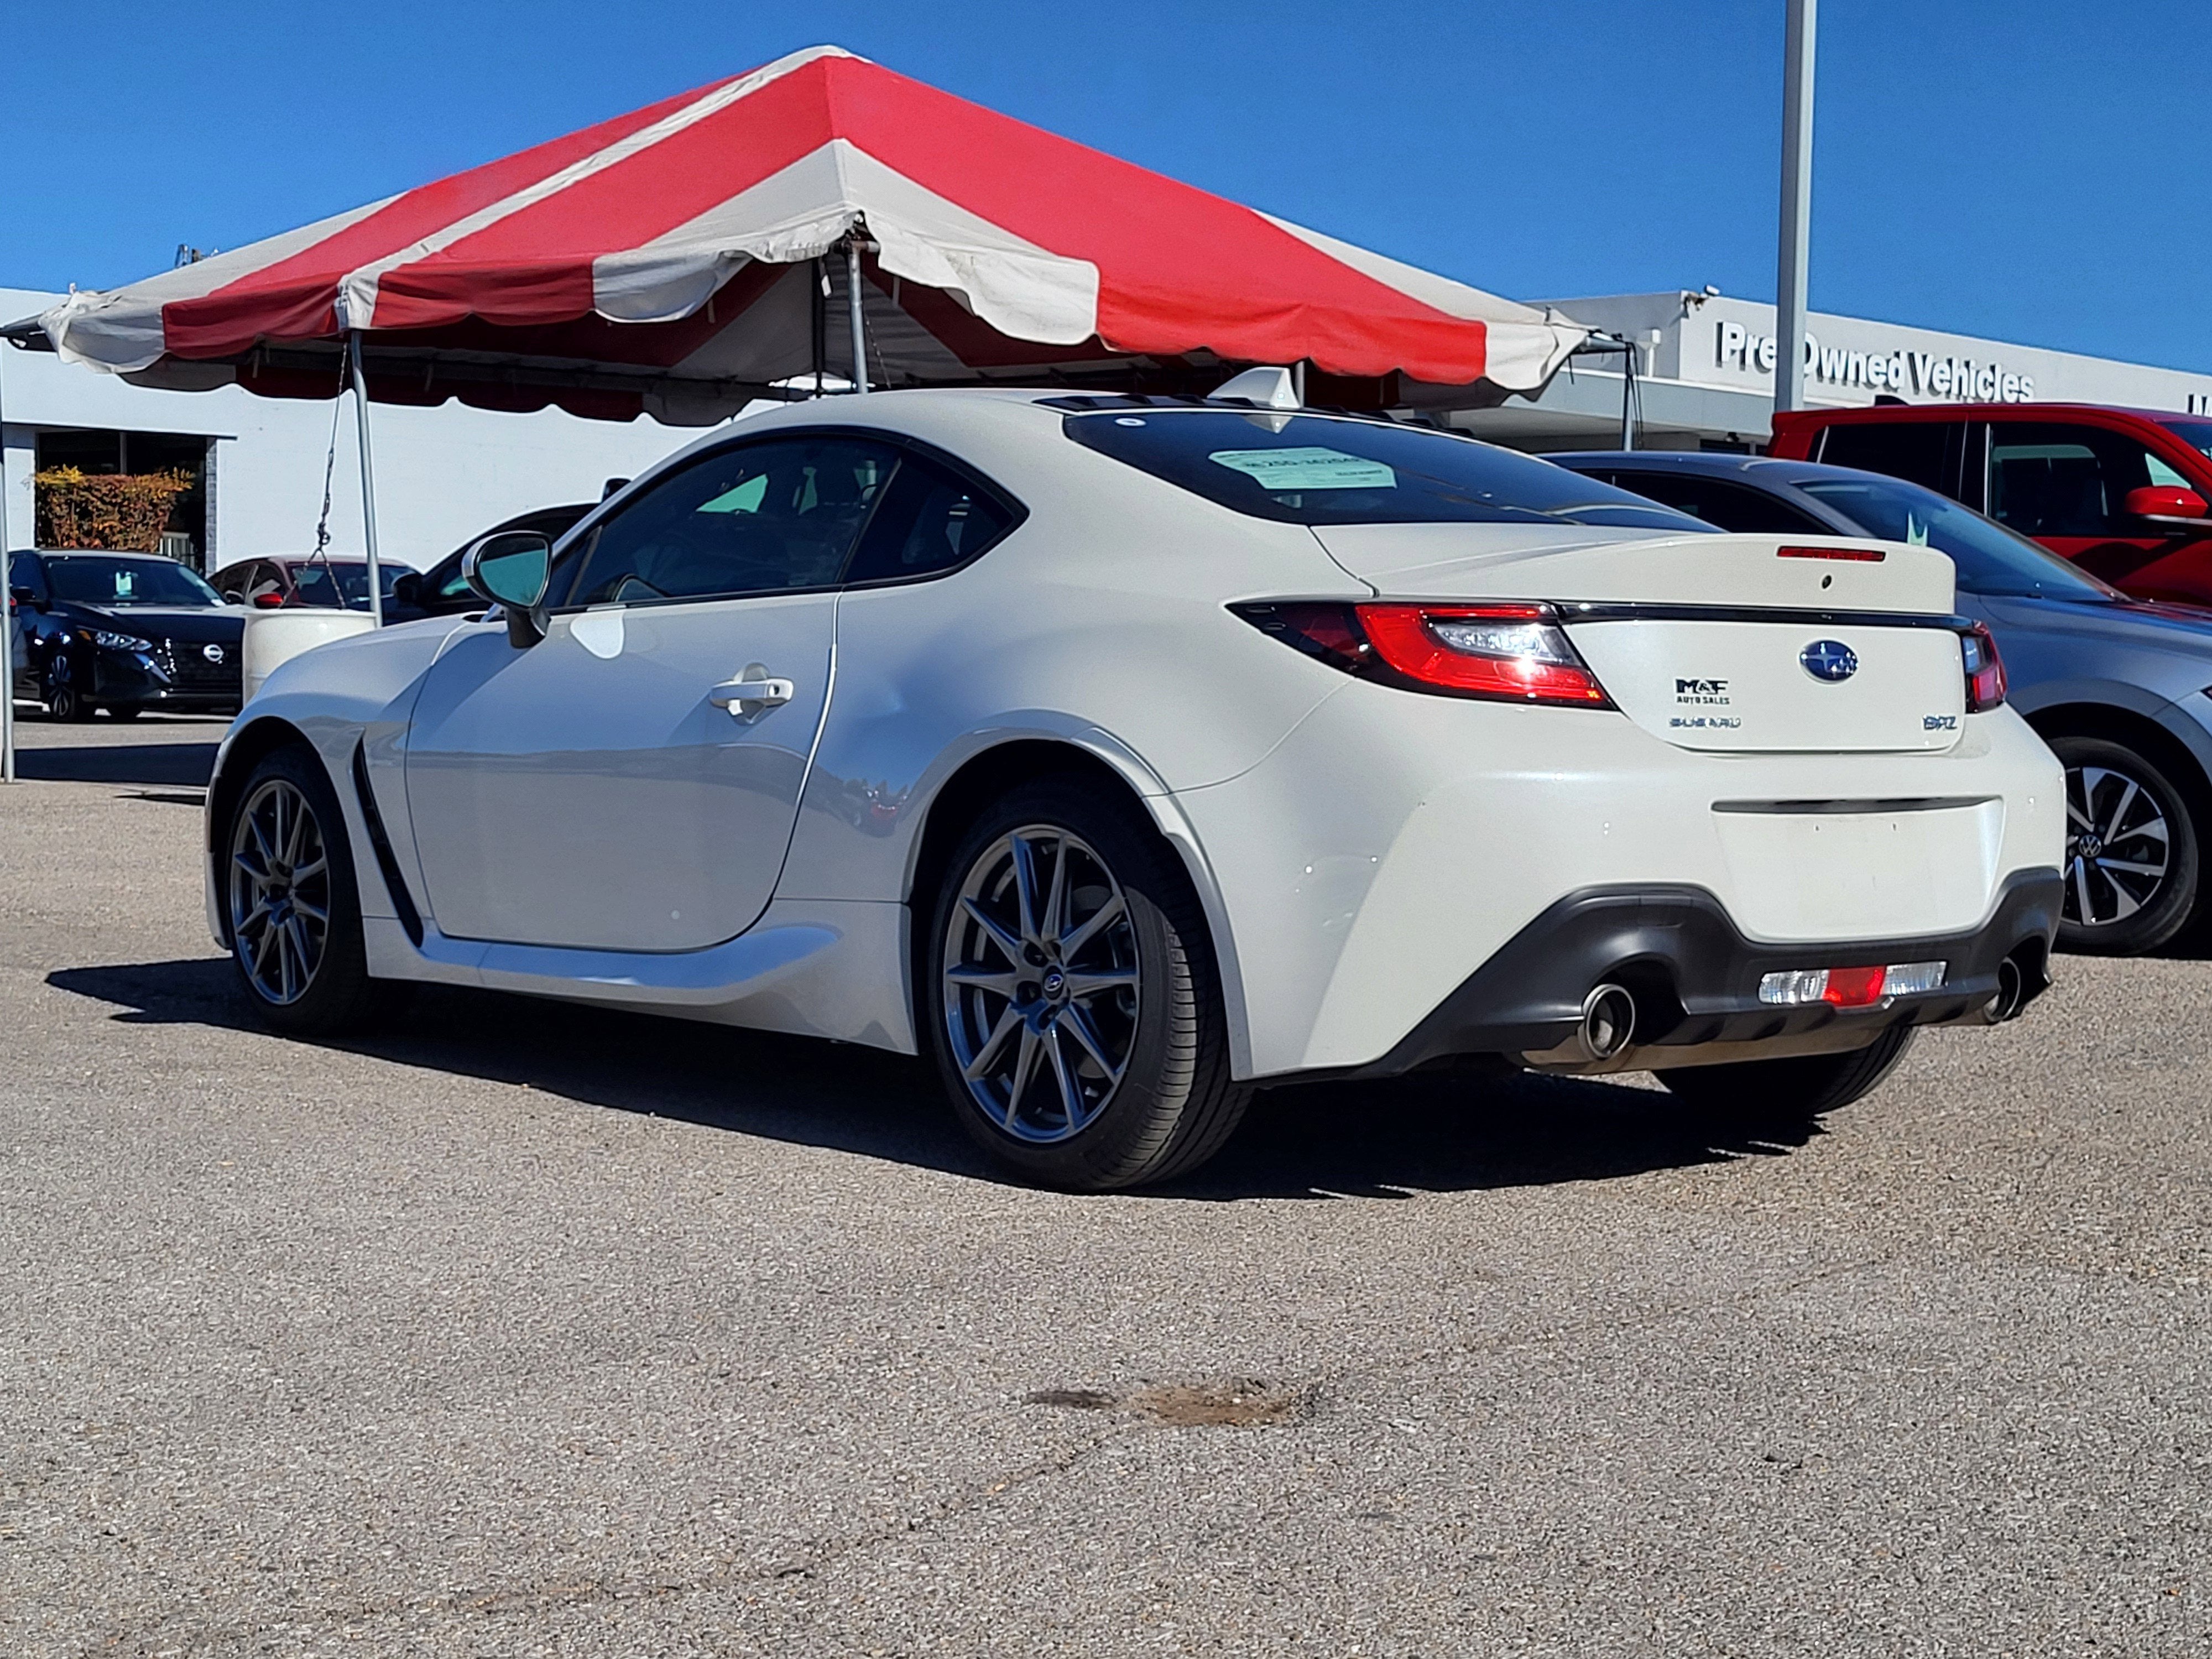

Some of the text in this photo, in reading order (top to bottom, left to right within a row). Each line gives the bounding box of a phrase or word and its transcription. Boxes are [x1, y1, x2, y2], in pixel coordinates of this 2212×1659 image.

[1716, 321, 1776, 372] Pre
[1910, 352, 2035, 404] Vehicles
[1676, 679, 1729, 694] M&F
[1677, 696, 1730, 705] AUTO SALES
[1670, 717, 1741, 728] SUBARU
[1923, 715, 1958, 730] BRZ
